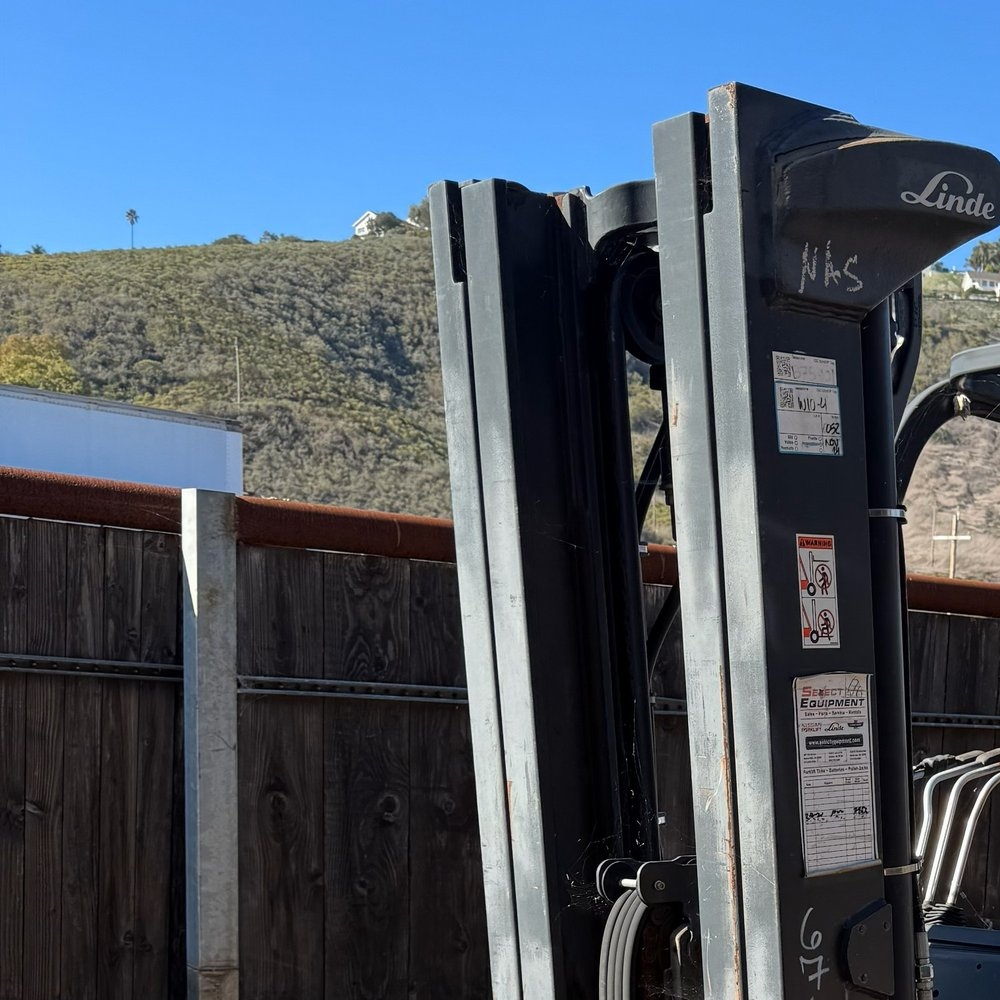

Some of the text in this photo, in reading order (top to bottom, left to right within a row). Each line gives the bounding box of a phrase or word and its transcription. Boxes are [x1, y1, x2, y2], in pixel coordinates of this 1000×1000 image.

[900, 170, 995, 220] Linde
[798, 239, 864, 294] NAS
[805, 539, 832, 547] WARNING
[801, 686, 845, 698] SELECT
[800, 698, 865, 708] EQUIPMENT
